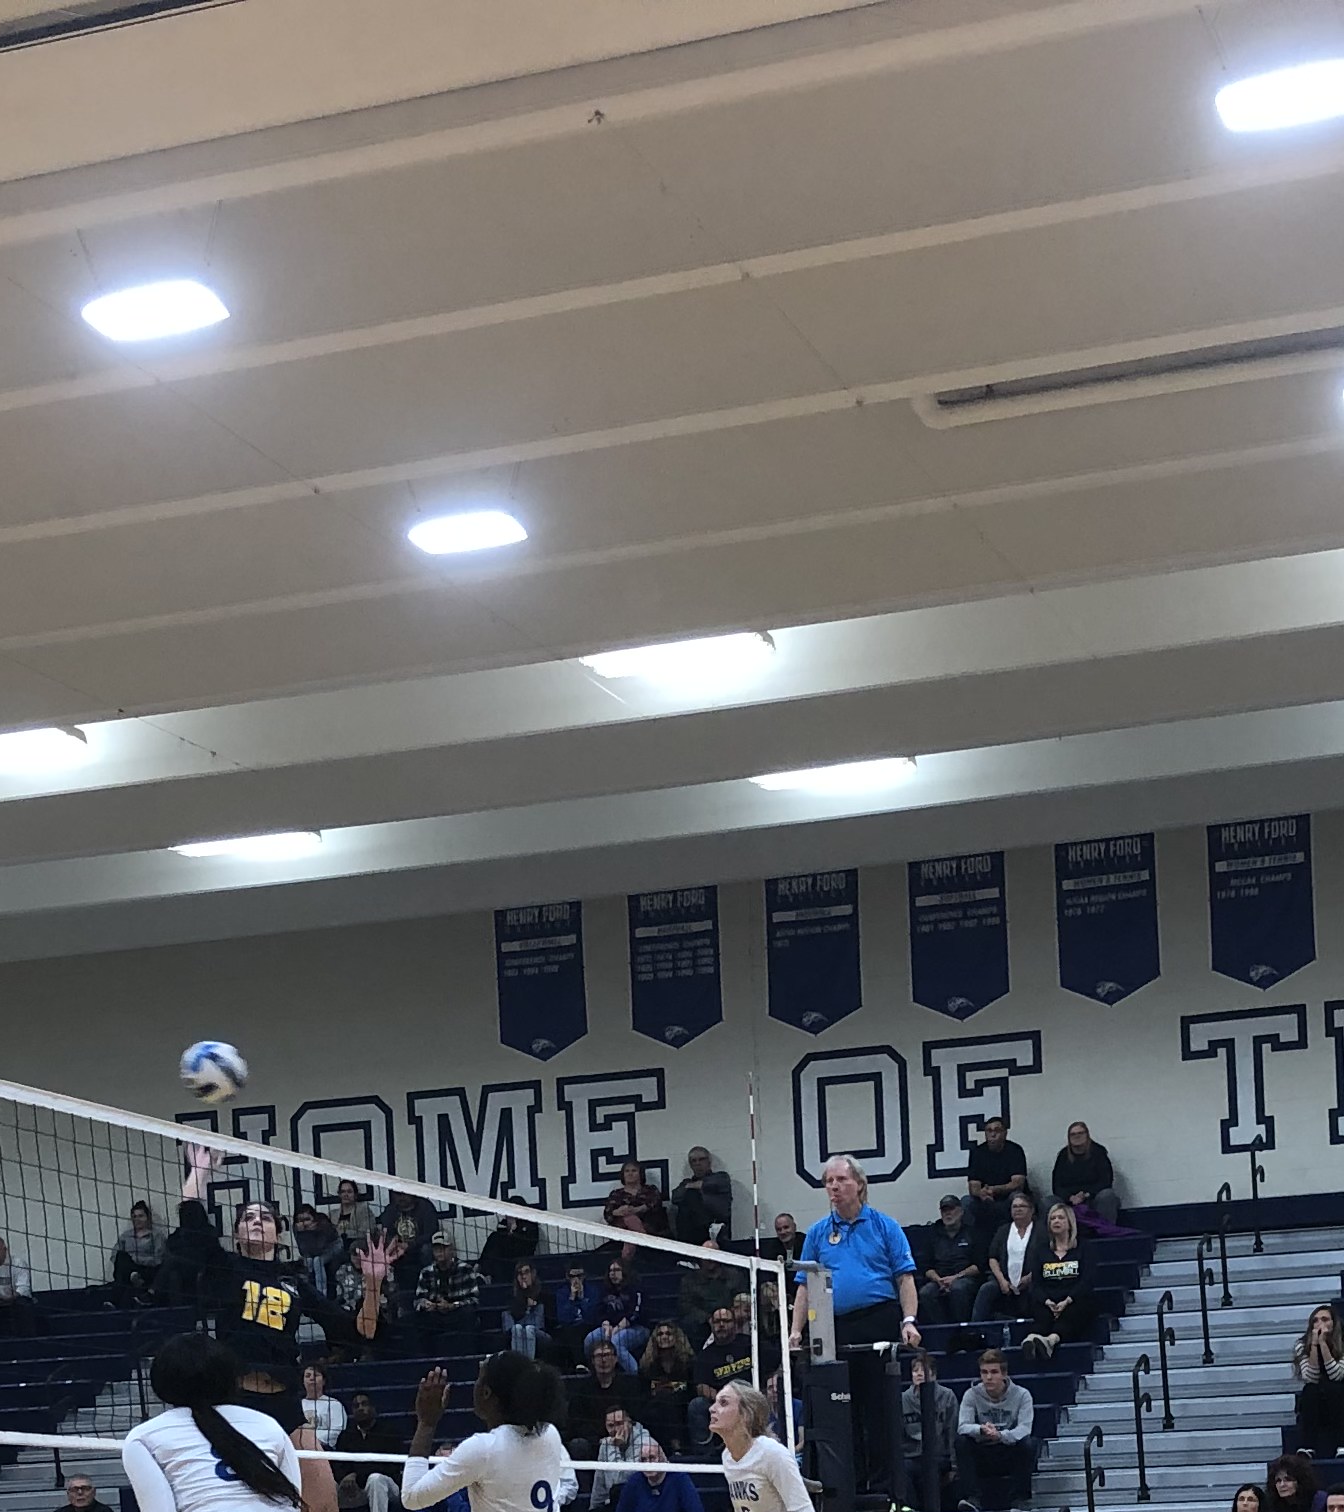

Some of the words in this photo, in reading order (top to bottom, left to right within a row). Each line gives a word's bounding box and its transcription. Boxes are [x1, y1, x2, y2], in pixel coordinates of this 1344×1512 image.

[1221, 823, 1260, 843] HENRY
[1264, 818, 1296, 839] FORD
[1068, 841, 1105, 862] HENRY
[1109, 837, 1141, 858] FORD
[921, 860, 957, 879] HENRY
[961, 855, 991, 874] FORD
[175, 1068, 670, 1232] HOME
[792, 1030, 1043, 1188] OF
[729, 1480, 759, 1502] AWKS
